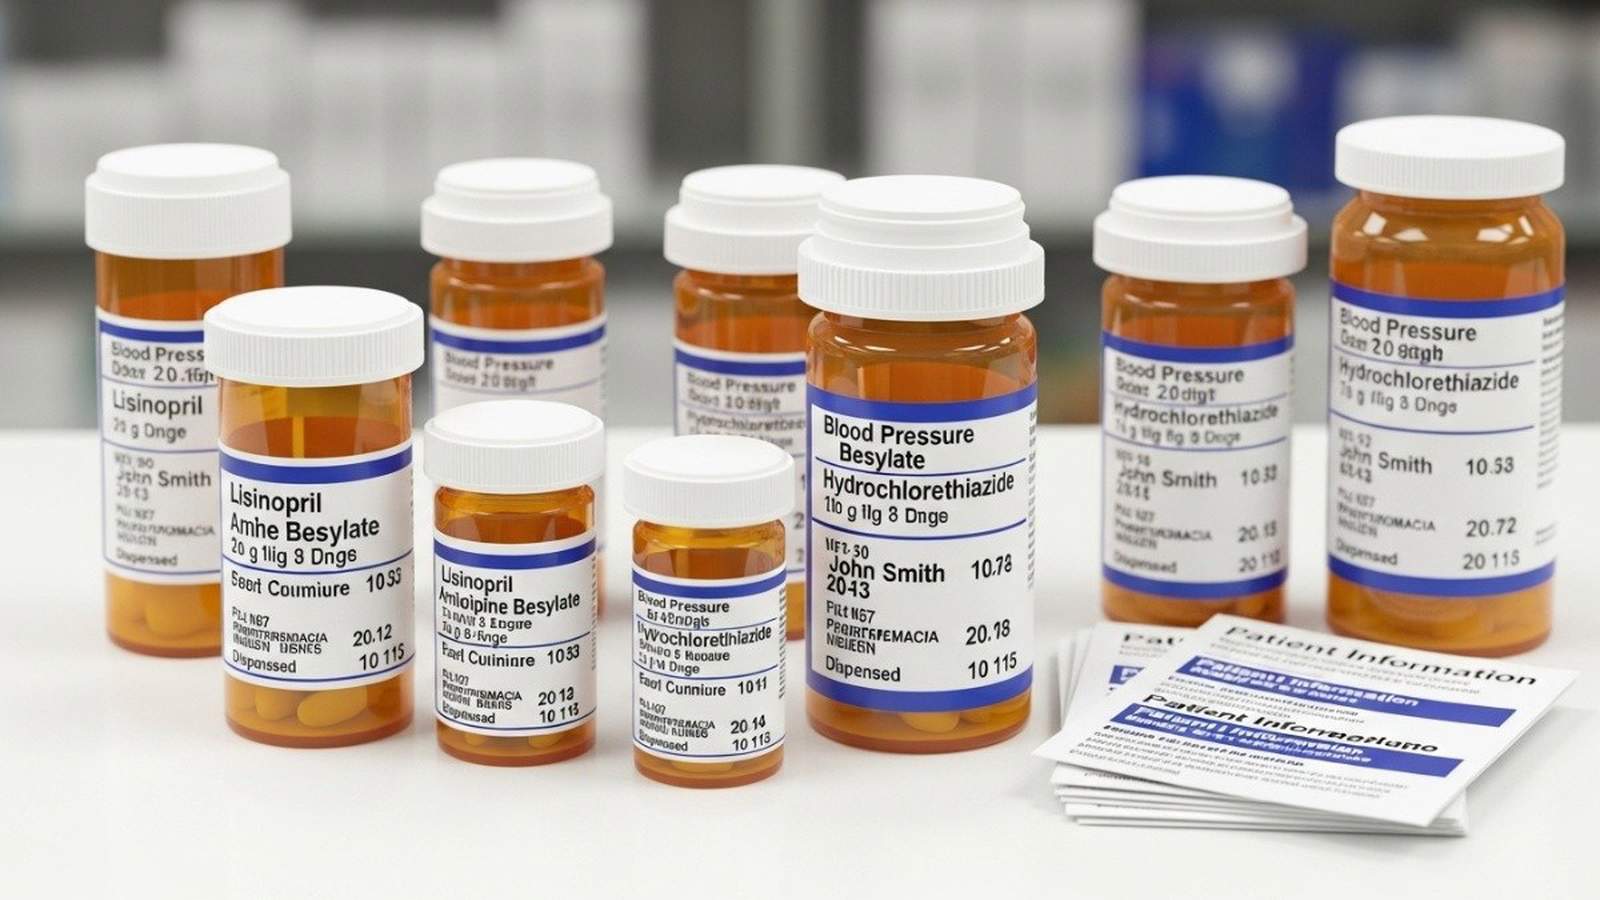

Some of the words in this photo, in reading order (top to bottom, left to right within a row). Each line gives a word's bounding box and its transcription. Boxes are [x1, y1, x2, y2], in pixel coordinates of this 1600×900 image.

[1386, 320, 1477, 342] Pressure
[155, 347, 205, 362] Press
[1372, 338, 1393, 356] 20
[485, 358, 554, 370] Pressure
[1162, 366, 1244, 383] Pressure
[726, 379, 796, 393] Pressure
[113, 389, 203, 419] Lisinopril
[824, 414, 874, 442] Blood
[880, 424, 974, 445] Pressure
[840, 442, 925, 472] Besylate
[1378, 452, 1432, 474] Smith
[158, 471, 212, 488] Smith
[823, 468, 1014, 500] Hydrochlorethiazide
[1162, 470, 1217, 489] Smith
[230, 481, 322, 517] Lisinopril
[286, 518, 380, 546] Besylate
[829, 556, 875, 580] John
[882, 562, 945, 582] Smith
[513, 593, 580, 616] Besylate
[670, 600, 730, 613] Pressure
[359, 653, 379, 670] 10
[1222, 624, 1341, 660] Patient
[1347, 649, 1537, 686] Information
[968, 660, 988, 680] 10
[538, 691, 556, 706] 20
[539, 710, 555, 723] 10
[730, 720, 748, 734] 20
[732, 738, 748, 751] 10
